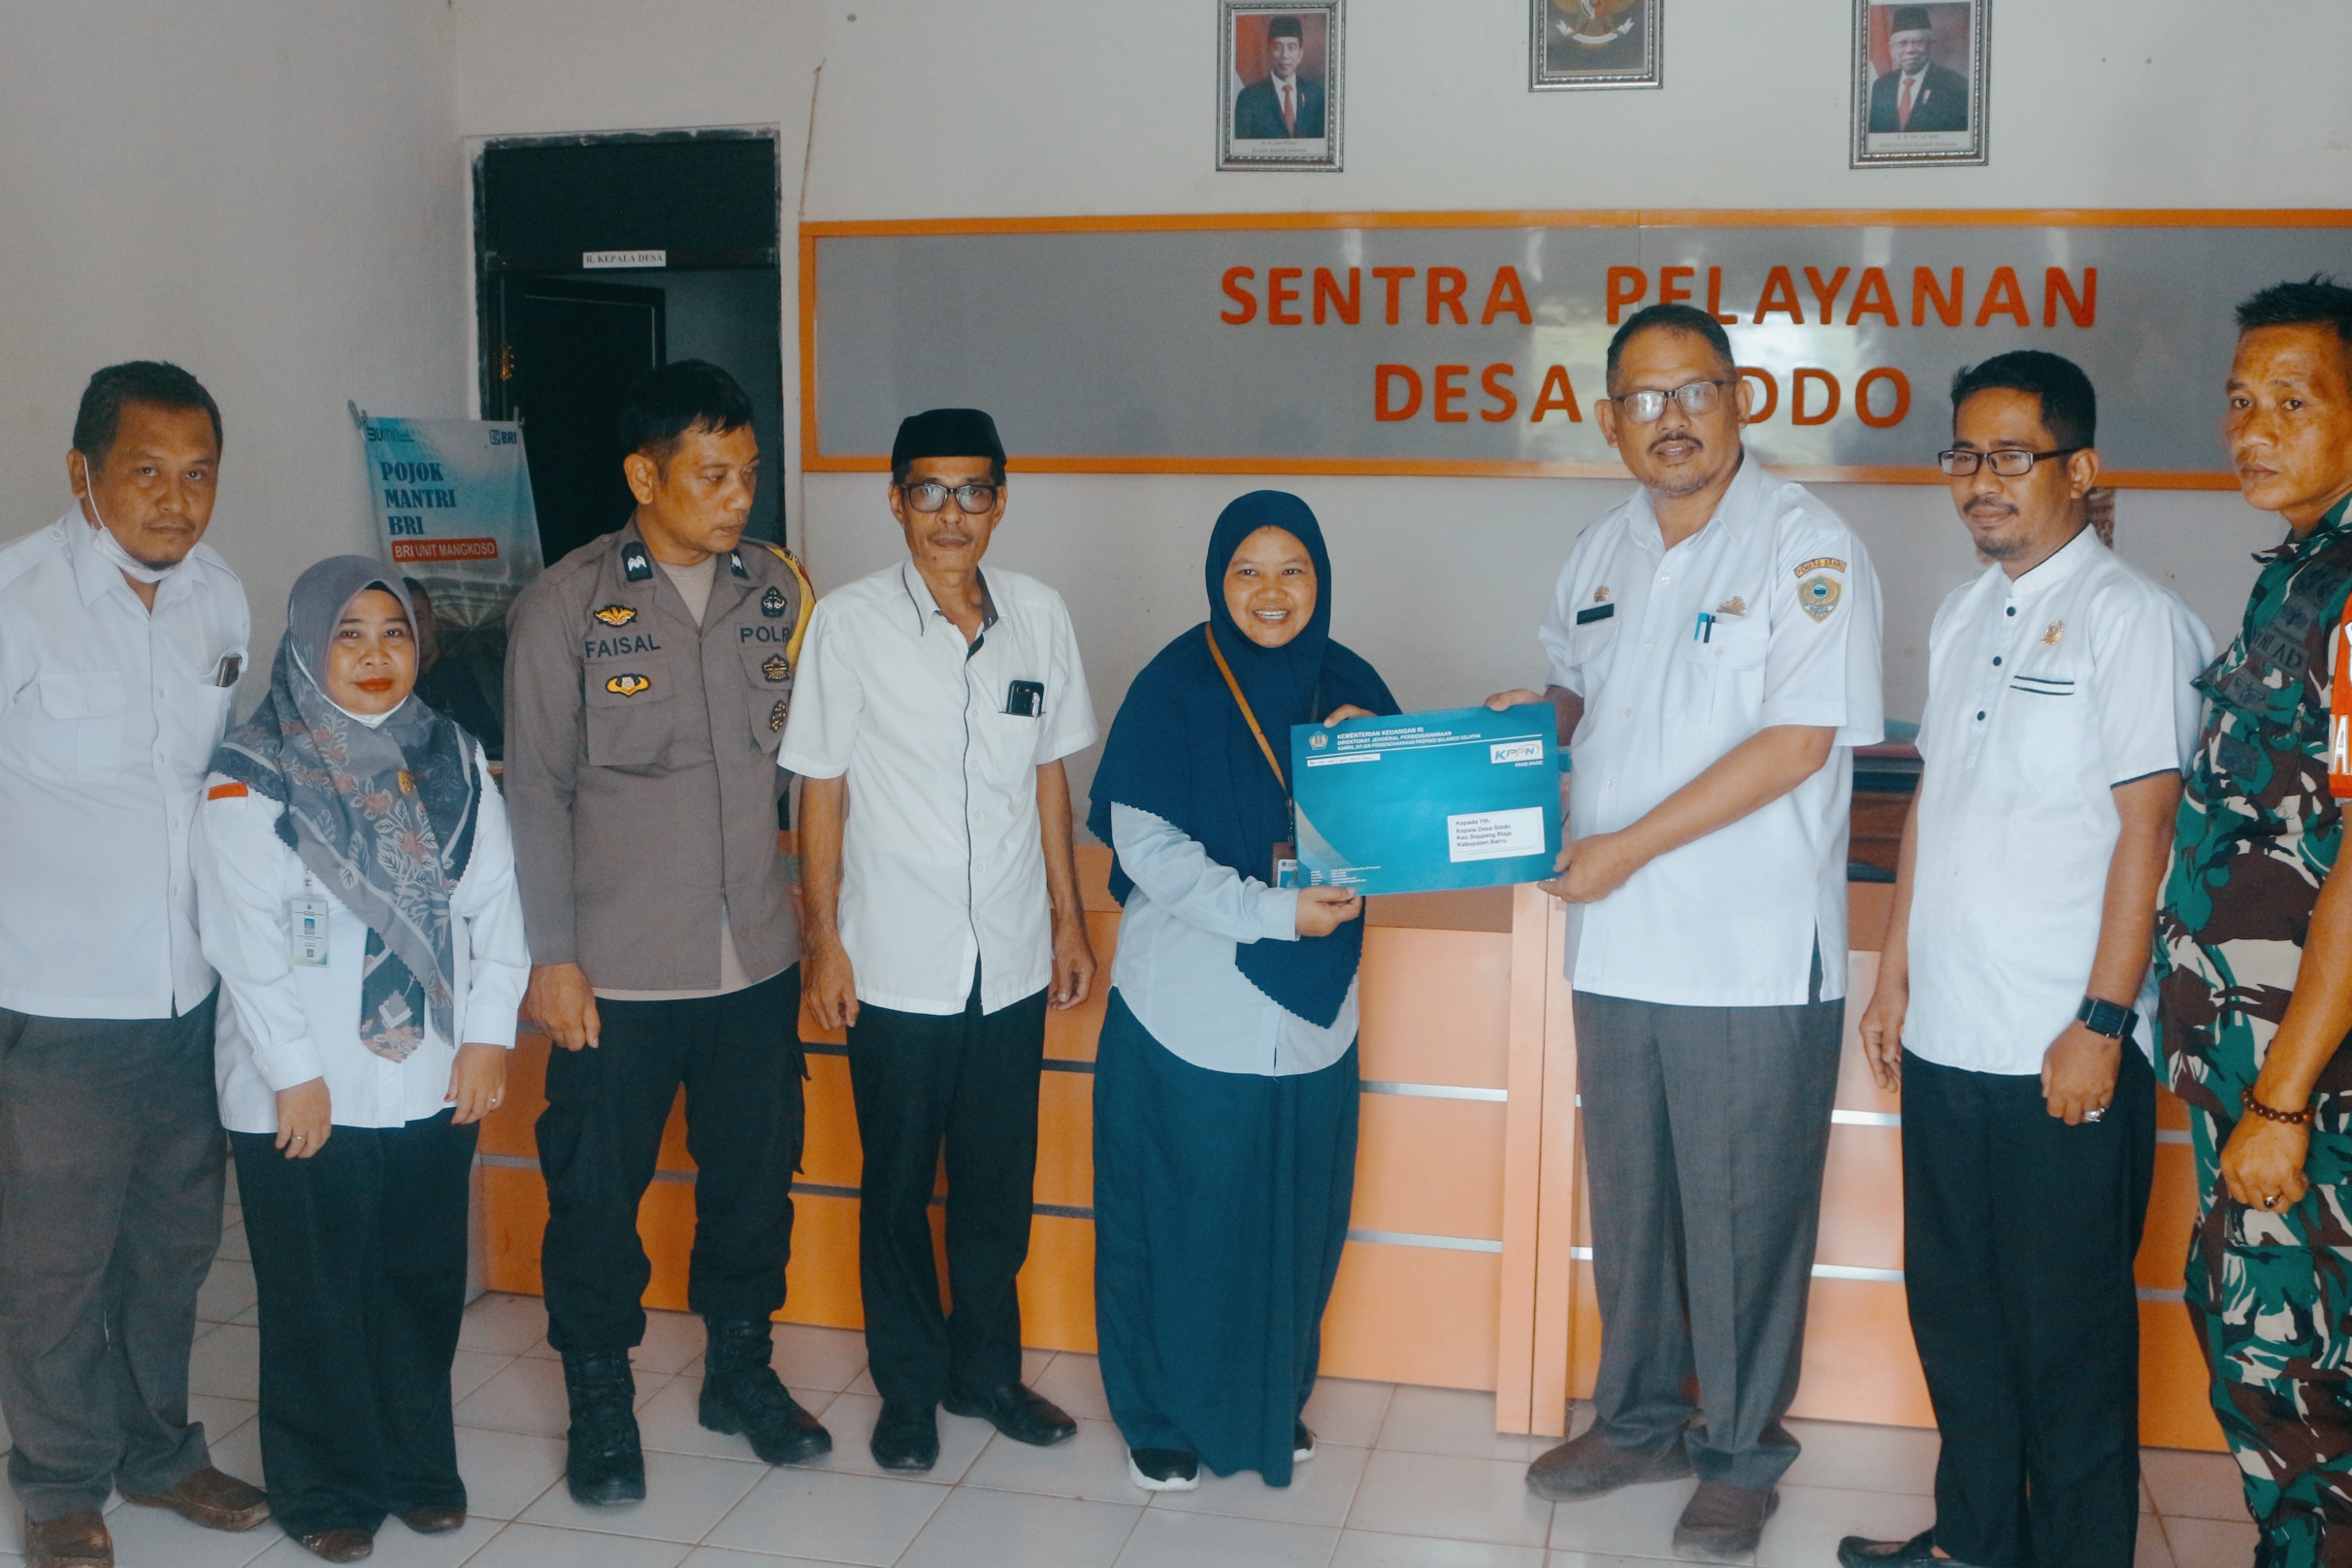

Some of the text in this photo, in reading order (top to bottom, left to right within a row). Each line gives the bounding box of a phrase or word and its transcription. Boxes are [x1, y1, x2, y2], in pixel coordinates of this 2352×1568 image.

[598, 254, 636, 263] KEPALA
[638, 253, 663, 262] DESA
[1220, 265, 2098, 328] SENTRA PELAYANAN
[1374, 363, 1911, 428] DESA DDO
[502, 431, 517, 444] BRI
[379, 462, 443, 482] POJOK
[384, 489, 457, 508] MANTRI
[387, 515, 425, 535] BRI
[395, 542, 495, 557] BRI UNIT MANGKOSO
[739, 626, 792, 643] POLR
[585, 634, 662, 659] FAISAL
[1337, 731, 1380, 739] KEMENTERIAN
[1494, 747, 1535, 761] KPPN
